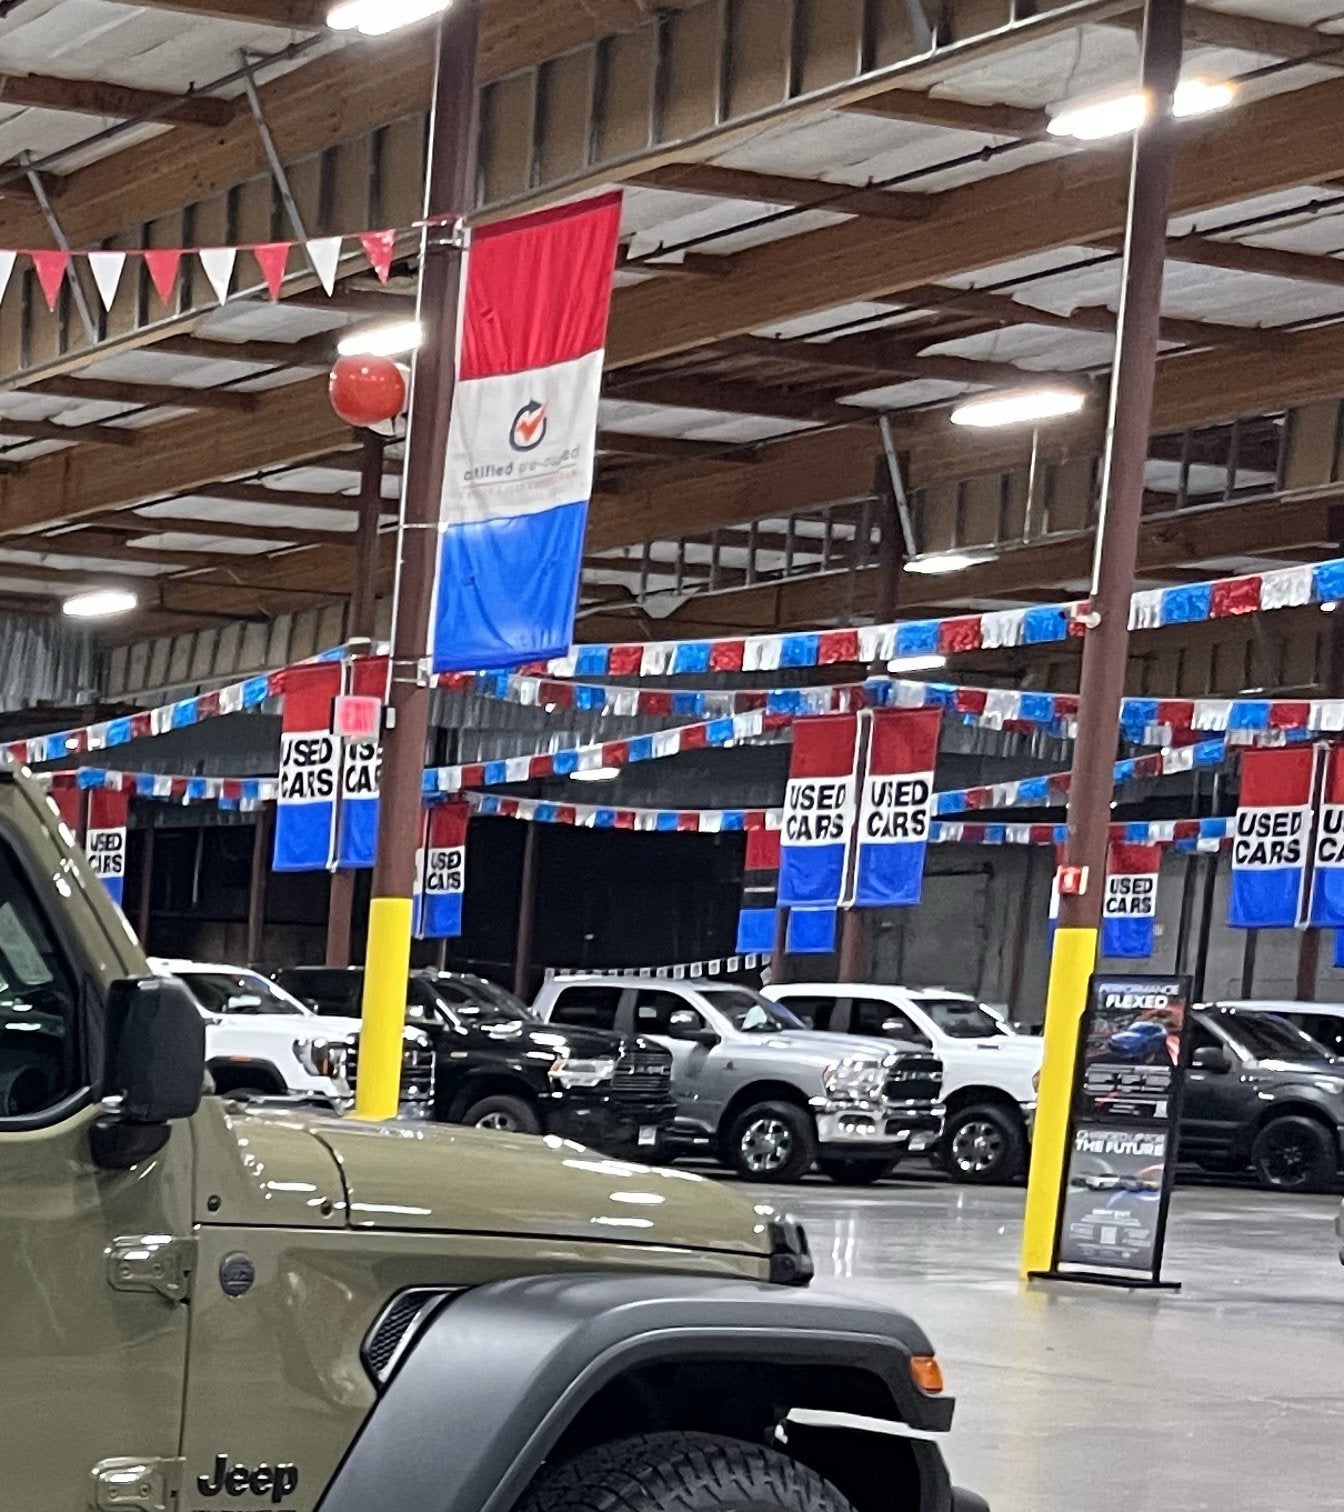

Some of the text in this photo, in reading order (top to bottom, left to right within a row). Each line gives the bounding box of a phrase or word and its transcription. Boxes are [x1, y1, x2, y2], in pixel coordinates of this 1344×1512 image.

[281, 738, 333, 767] USED
[281, 768, 333, 798] CARS
[345, 765, 380, 793] CA
[790, 783, 847, 811] USED
[871, 780, 929, 808] USED
[786, 813, 844, 841] CARS
[867, 809, 927, 838] CARS
[1237, 811, 1302, 837] USED
[1235, 838, 1301, 865] CARS
[1109, 877, 1153, 895] USED
[1106, 897, 1152, 914] CARS
[1105, 994, 1169, 1010] FLEXED
[1075, 1139, 1166, 1157] THE FUTURE
[197, 1453, 298, 1504] Jeep
